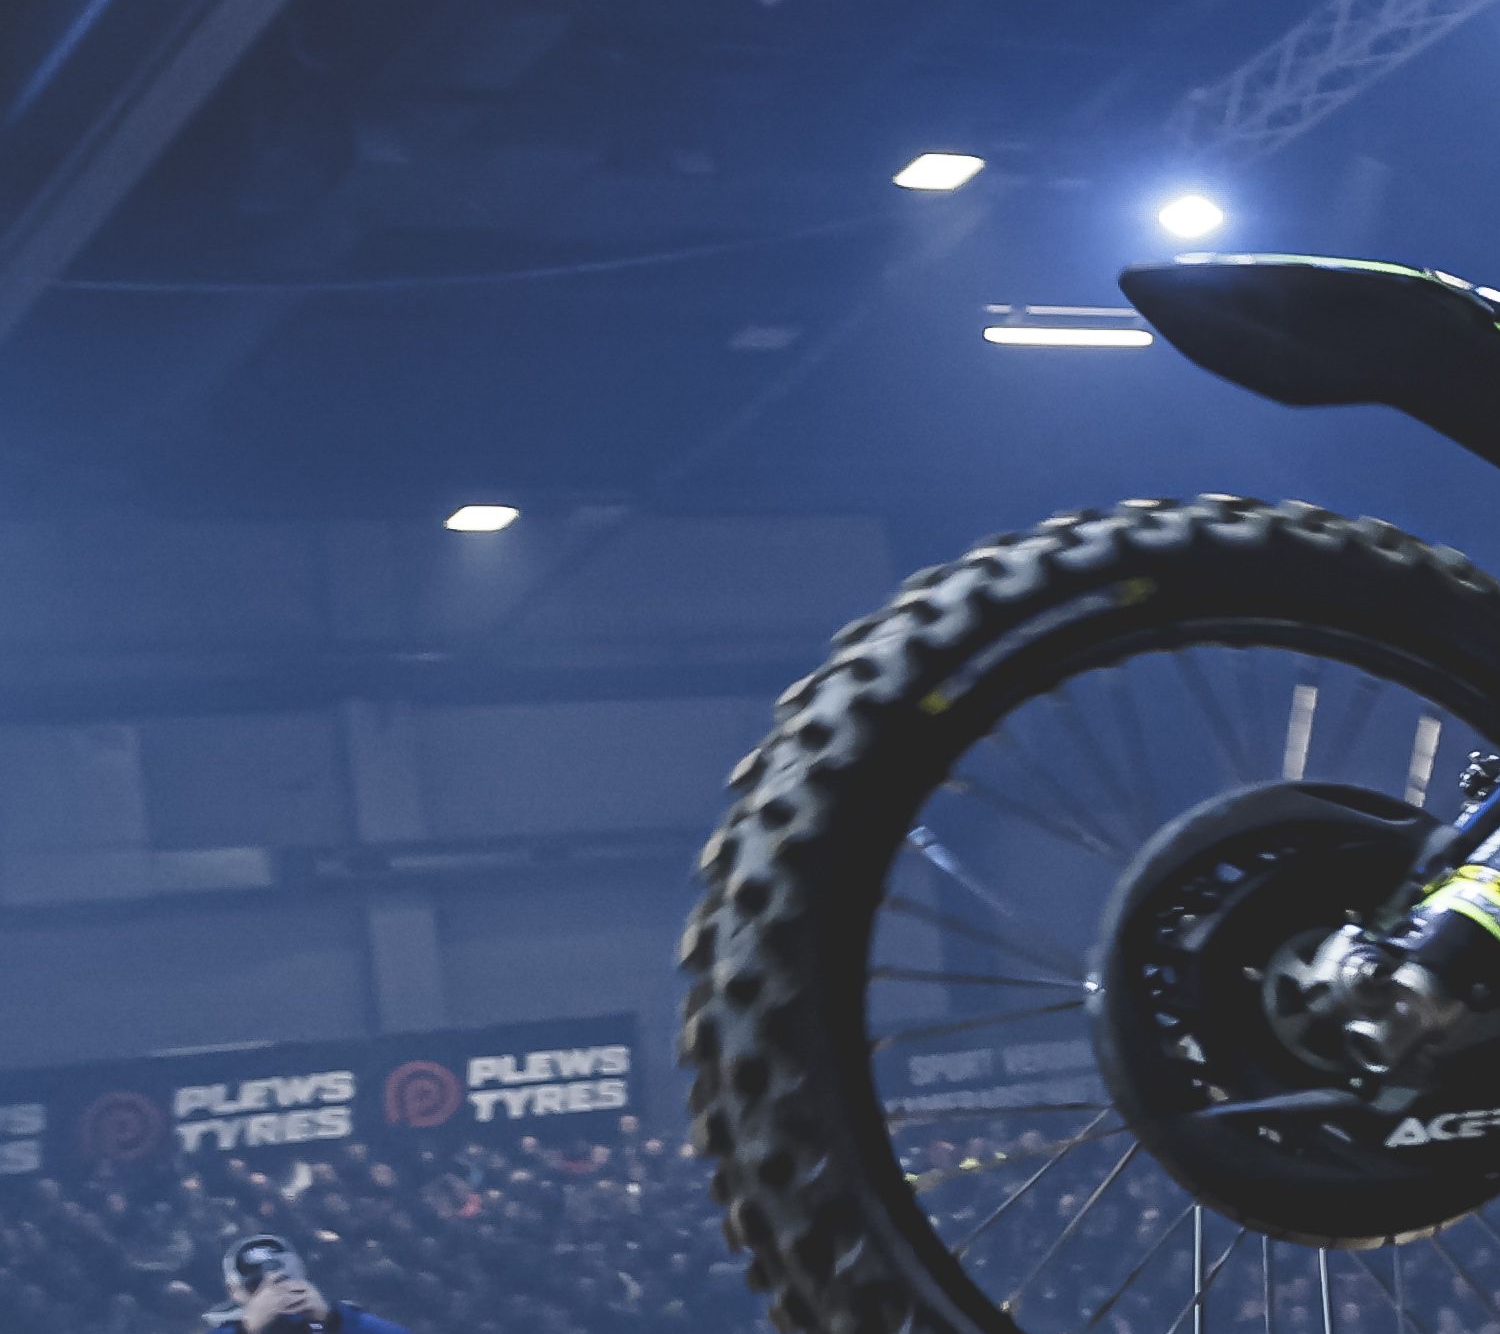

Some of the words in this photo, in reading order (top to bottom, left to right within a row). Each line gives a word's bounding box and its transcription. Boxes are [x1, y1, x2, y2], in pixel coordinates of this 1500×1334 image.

[467, 1044, 631, 1087] PLEWS
[173, 1070, 356, 1118] PLEWS
[467, 1078, 629, 1122] TYRES
[174, 1105, 352, 1154] TYRES
